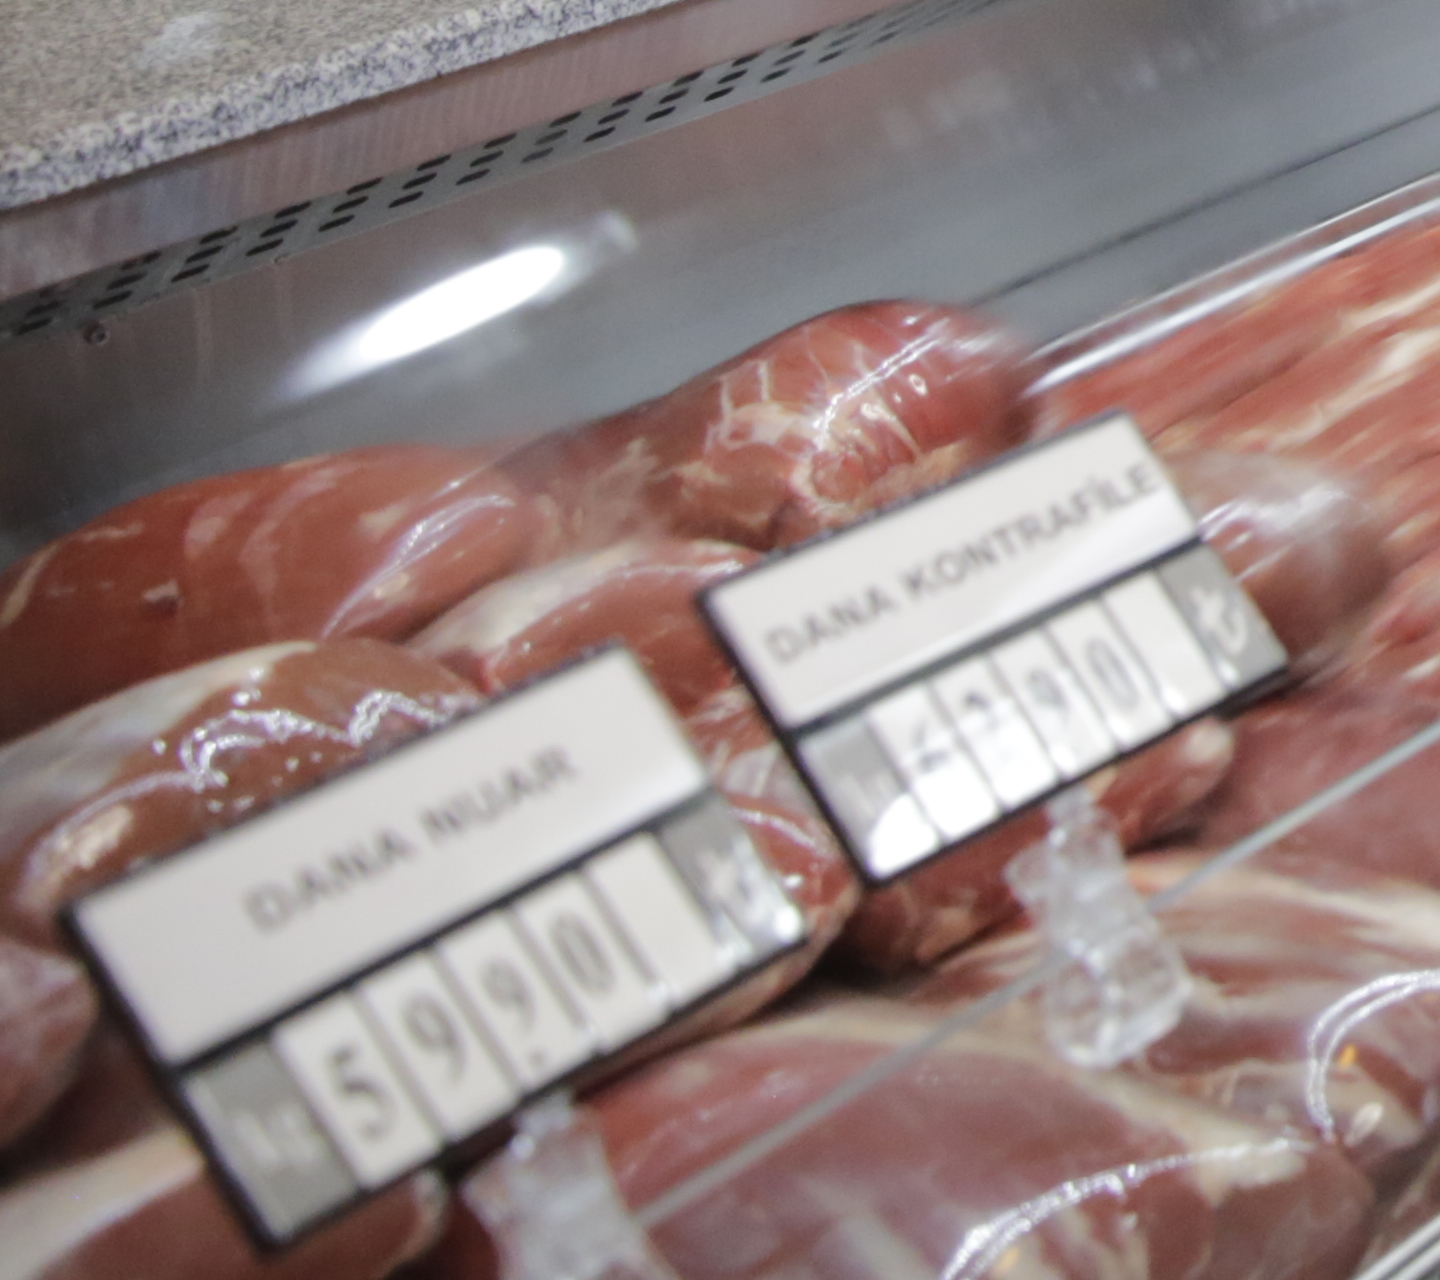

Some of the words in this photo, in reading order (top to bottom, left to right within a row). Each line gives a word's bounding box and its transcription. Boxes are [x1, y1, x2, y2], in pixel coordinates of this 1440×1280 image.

[766, 586, 899, 664] DANA
[906, 461, 1160, 596] KONTRAFİLE
[245, 834, 425, 933] DANA
[425, 743, 580, 848] NUAR
